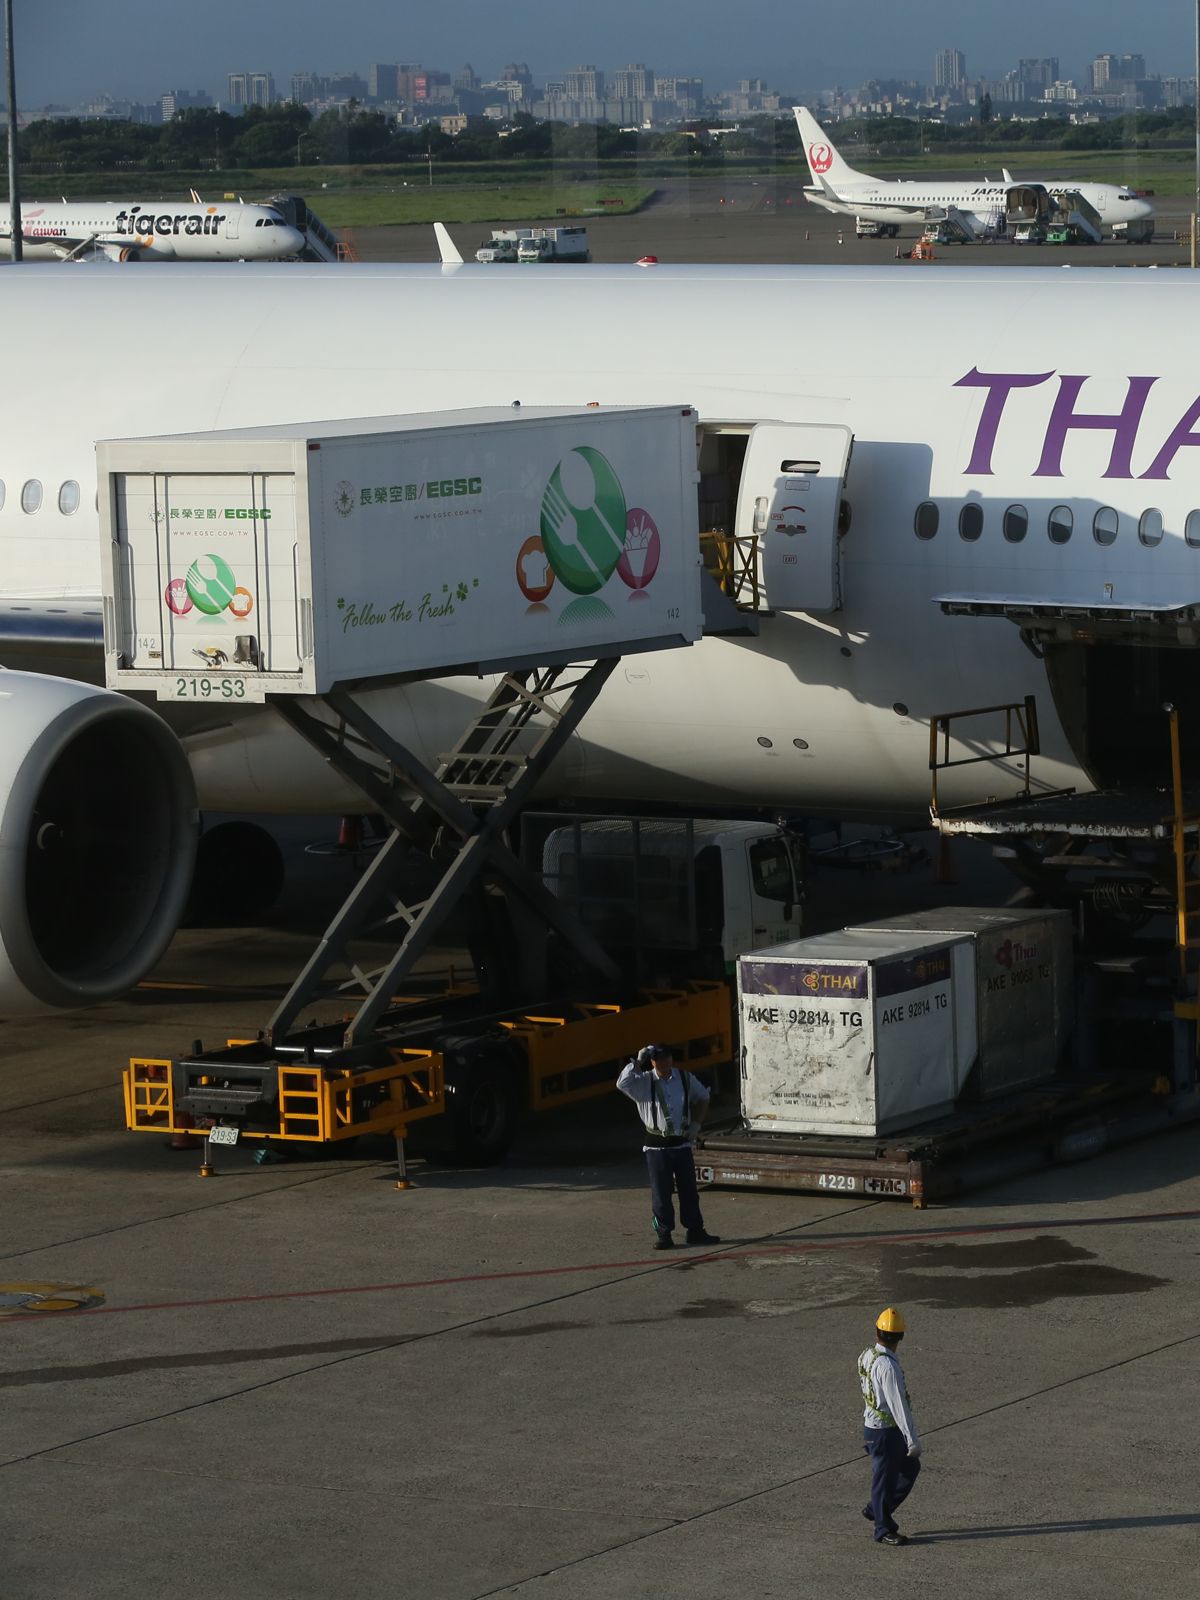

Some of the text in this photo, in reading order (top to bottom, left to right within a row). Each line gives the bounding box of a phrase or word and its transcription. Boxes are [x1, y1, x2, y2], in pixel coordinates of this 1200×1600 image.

[115, 206, 226, 247] tigerair
[343, 592, 455, 634] Follow the Fresh
[667, 607, 680, 620] 142
[138, 638, 155, 649] 142
[177, 678, 245, 698] 219-S3
[823, 975, 858, 990] THAI
[748, 1007, 863, 1027] AKE 92814 TG
[882, 993, 948, 1025] AKE 92814 TG
[211, 1130, 237, 1143] 219-S3
[818, 1174, 856, 1191] 4229
